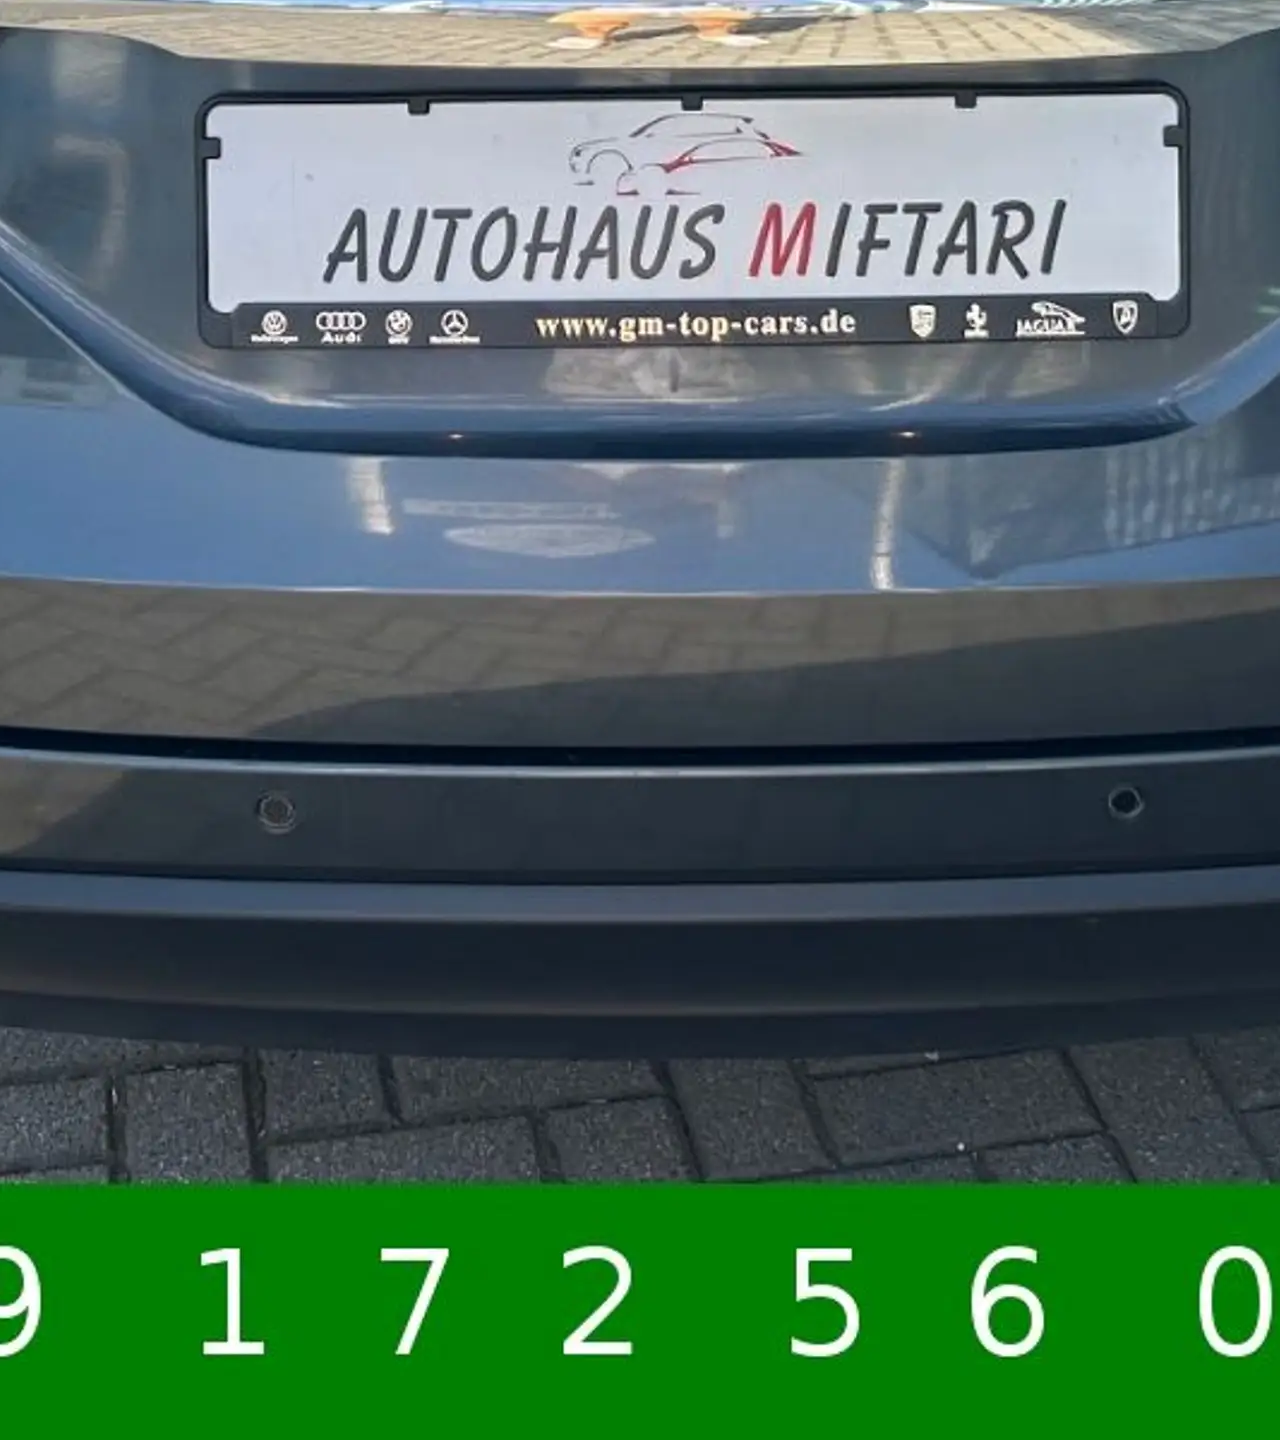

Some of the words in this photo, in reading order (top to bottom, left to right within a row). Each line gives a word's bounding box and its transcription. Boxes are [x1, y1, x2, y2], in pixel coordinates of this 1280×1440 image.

[322, 203, 726, 283] AUTOHAUS
[747, 198, 1067, 280] MIFTARI
[321, 332, 362, 344] Audi
[535, 308, 857, 343] www.gm-top-cars.de
